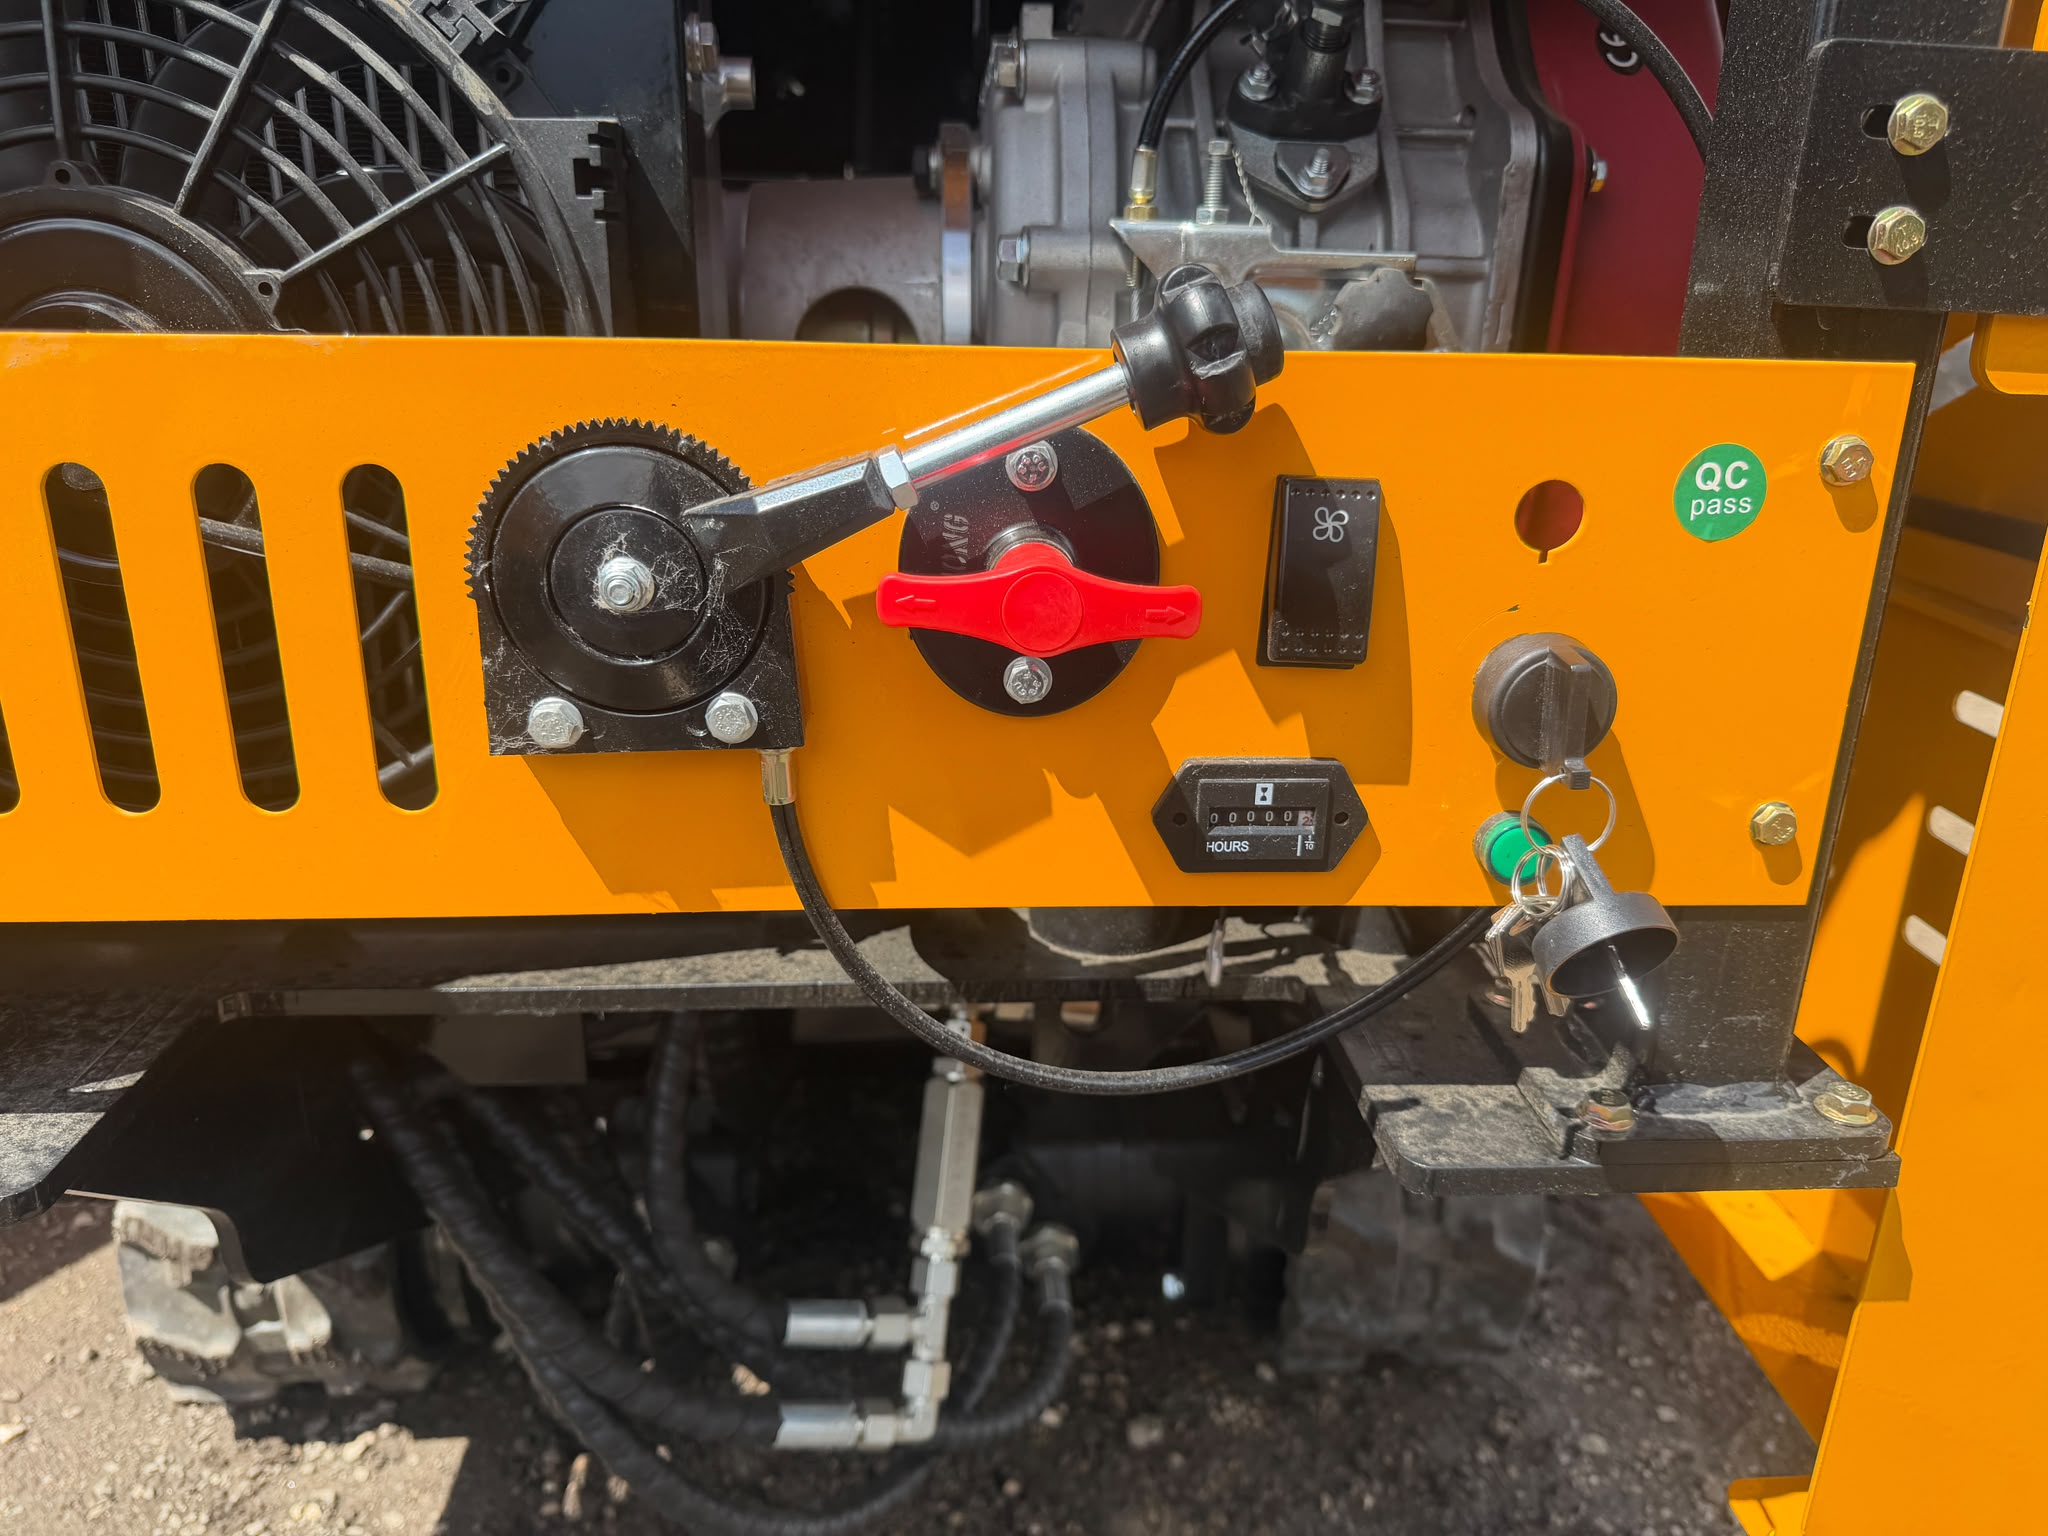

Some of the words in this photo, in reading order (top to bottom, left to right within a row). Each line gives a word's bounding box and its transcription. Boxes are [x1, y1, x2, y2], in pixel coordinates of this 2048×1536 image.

[1695, 461, 1749, 492] QC
[1690, 497, 1752, 521] pass
[941, 513, 969, 575] ONG
[1206, 840, 1249, 853] HOURS
